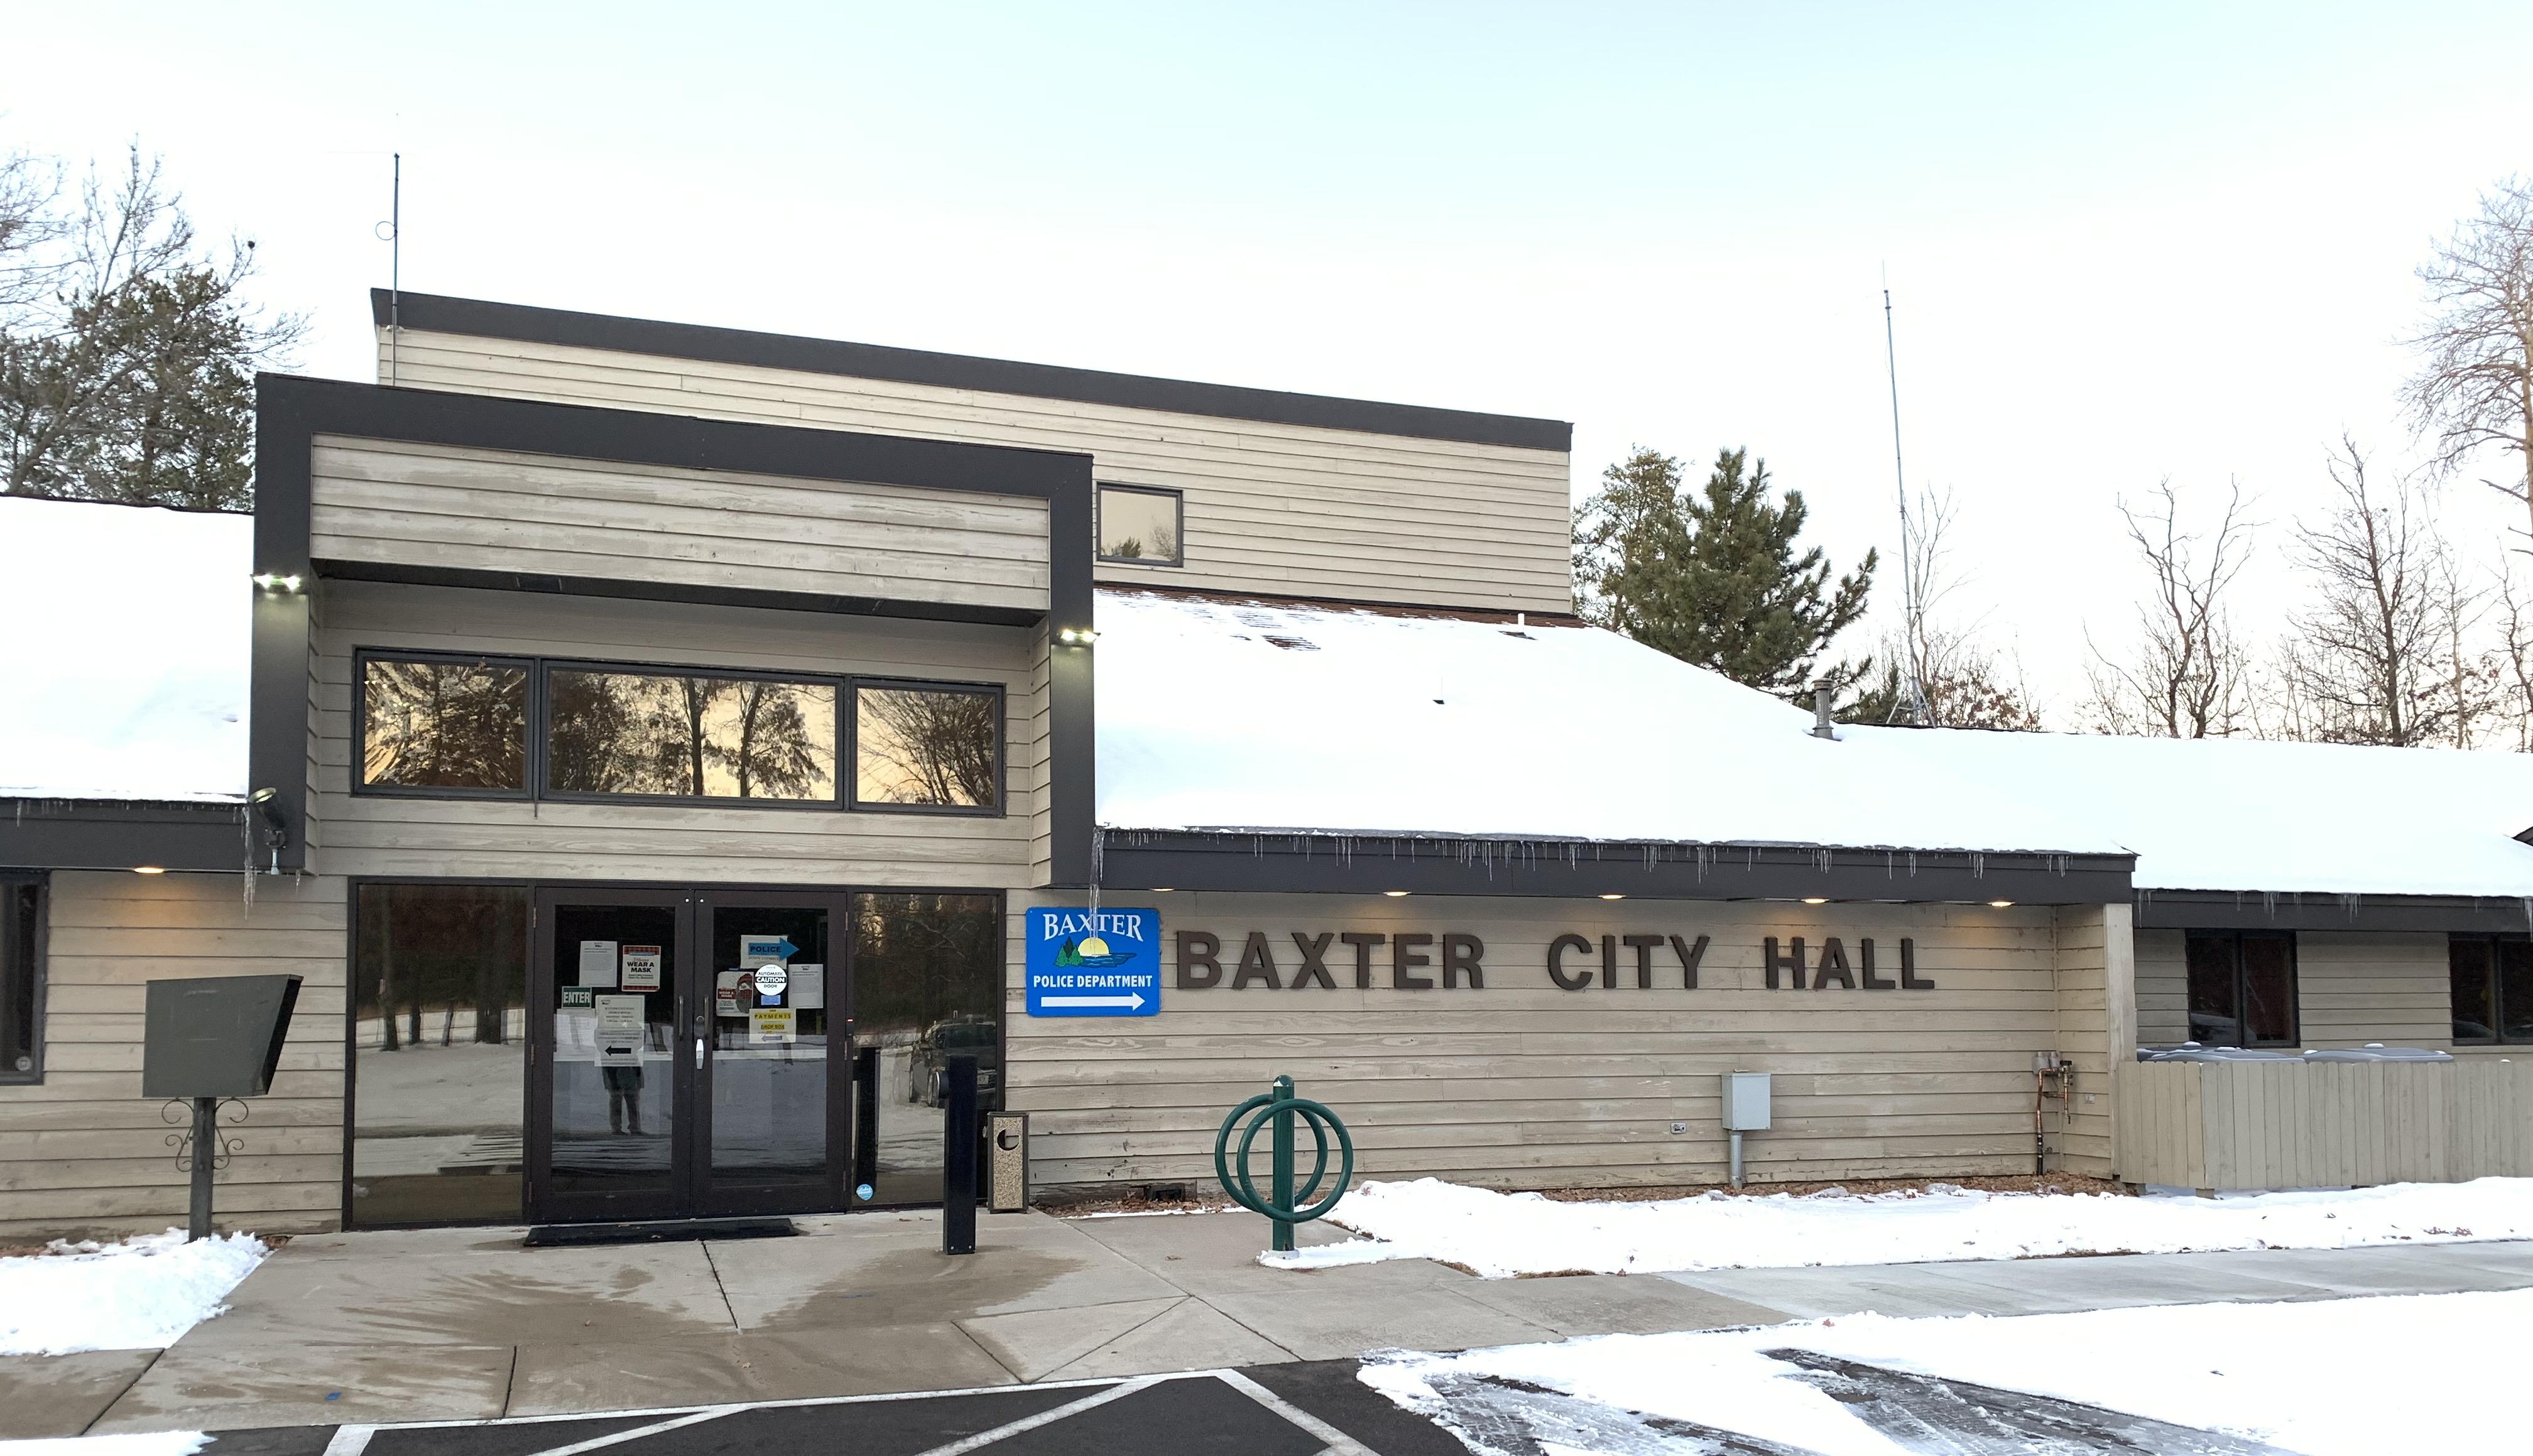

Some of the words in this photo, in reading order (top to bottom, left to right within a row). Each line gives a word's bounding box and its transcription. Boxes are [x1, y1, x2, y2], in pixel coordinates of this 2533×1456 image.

[1043, 914, 1143, 942] BAXTER
[1177, 930, 1484, 989] BAXTER
[1547, 934, 1711, 990] CITY
[1764, 937, 1936, 990] HALL
[1033, 975, 1074, 988] POLICE
[1077, 975, 1153, 988] DEPARTMENT
[563, 992, 591, 1004] ENTER
